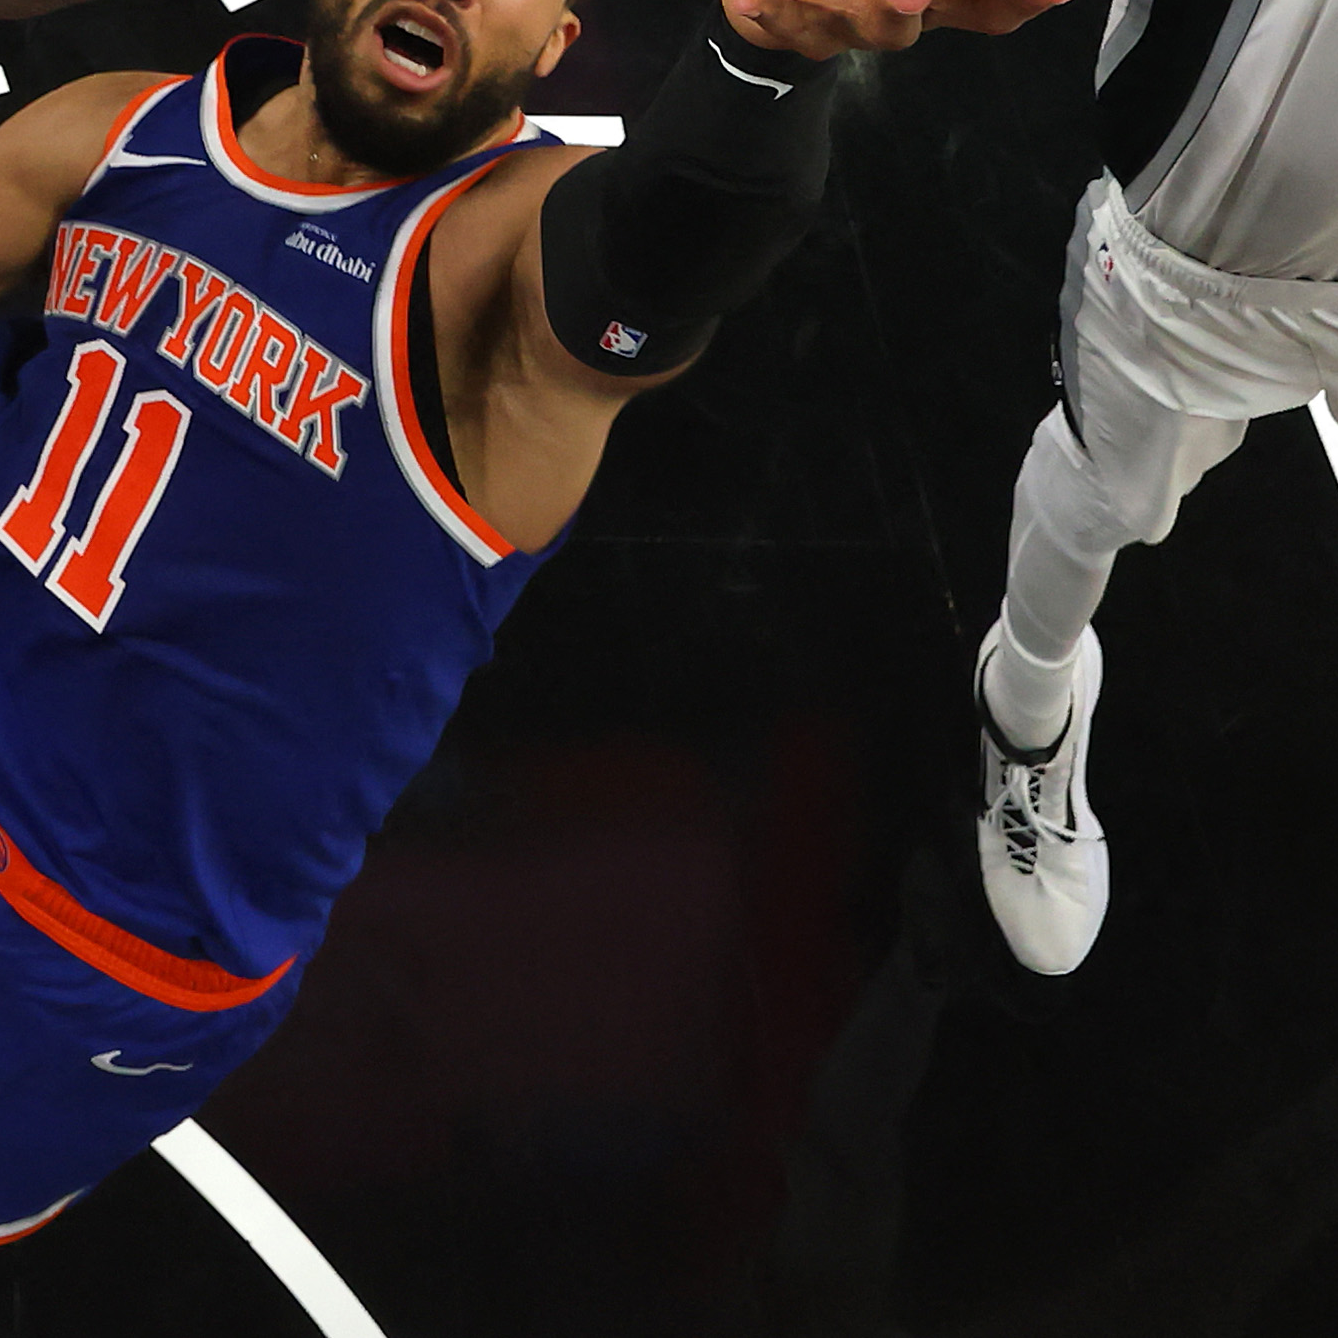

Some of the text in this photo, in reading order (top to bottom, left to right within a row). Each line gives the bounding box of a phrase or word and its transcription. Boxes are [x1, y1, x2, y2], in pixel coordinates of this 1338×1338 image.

[285, 231, 316, 255] abu
[316, 243, 376, 283] dhabi
[44, 220, 372, 482] NEW YORK
